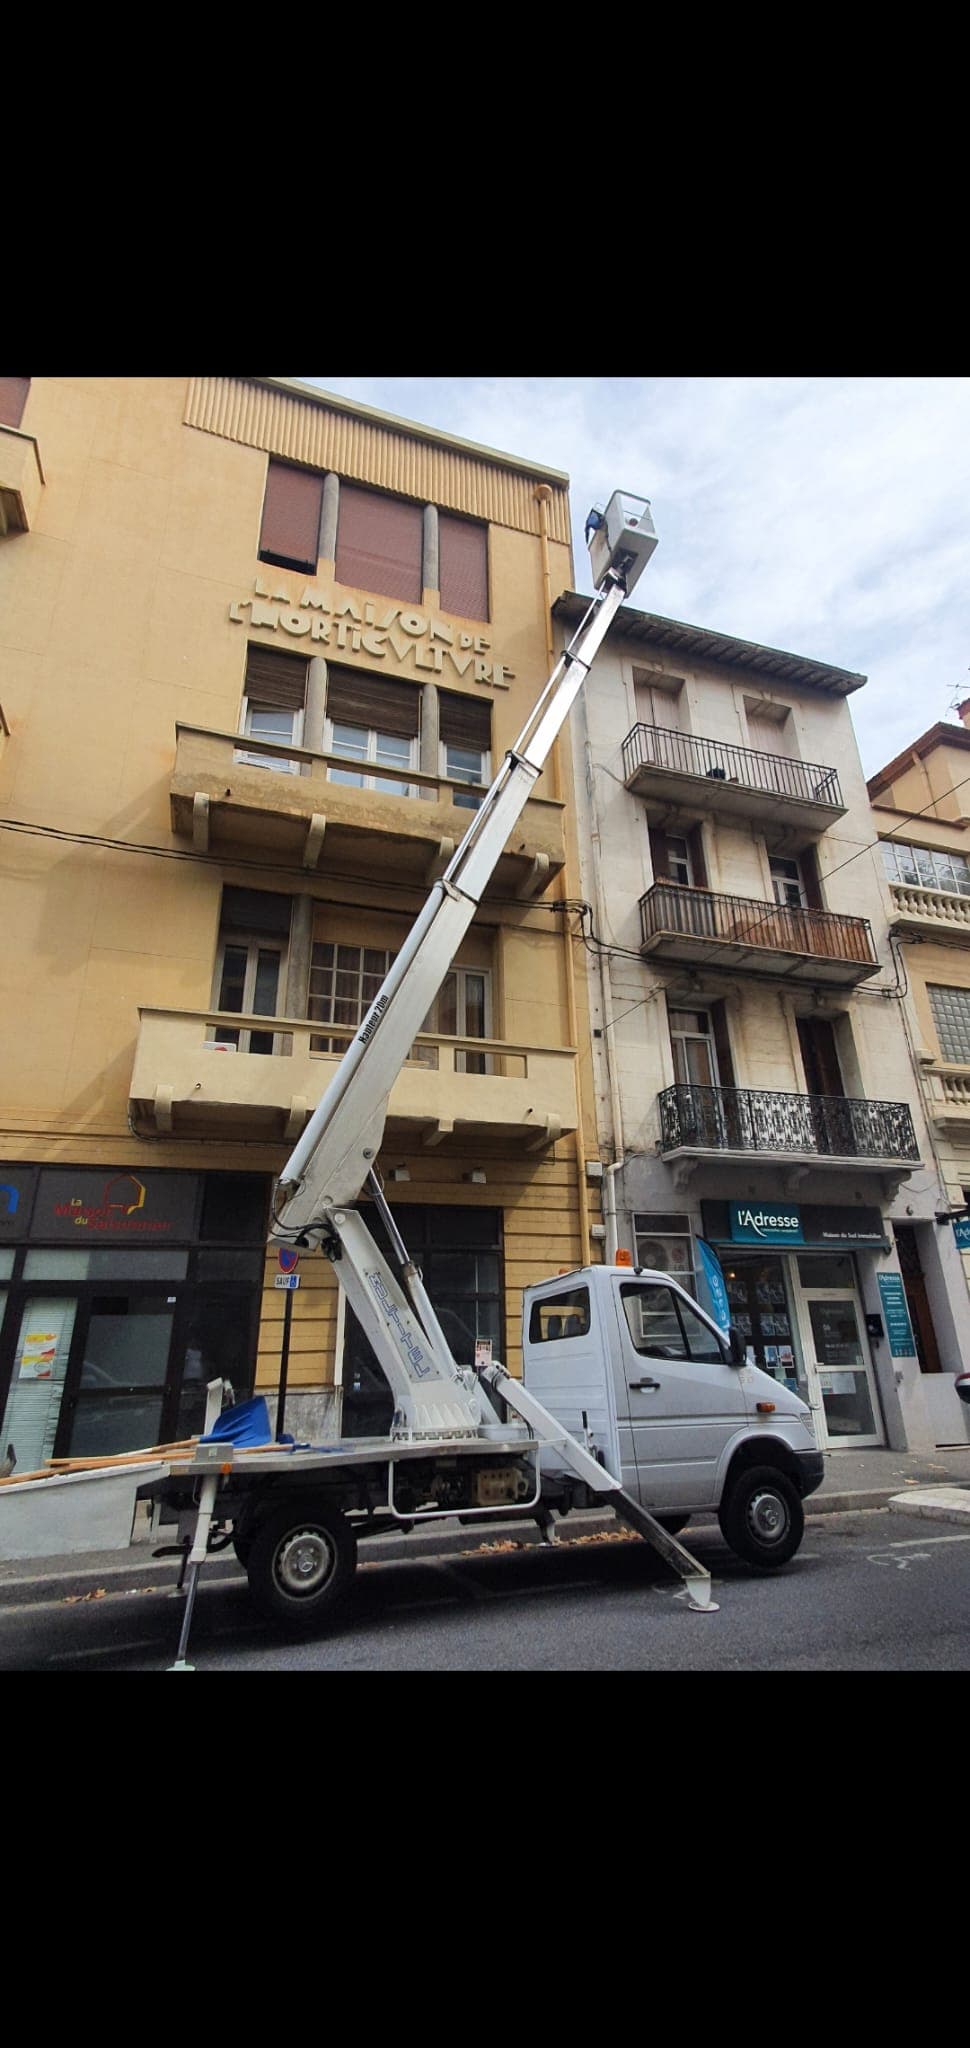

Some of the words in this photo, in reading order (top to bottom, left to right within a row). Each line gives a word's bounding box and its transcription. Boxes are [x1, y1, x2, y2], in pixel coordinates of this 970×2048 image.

[254, 576, 290, 604] LA
[459, 631, 491, 655] DE
[71, 1197, 83, 1207] La
[74, 1215, 89, 1225] du
[738, 1209, 800, 1238] l'Adresse
